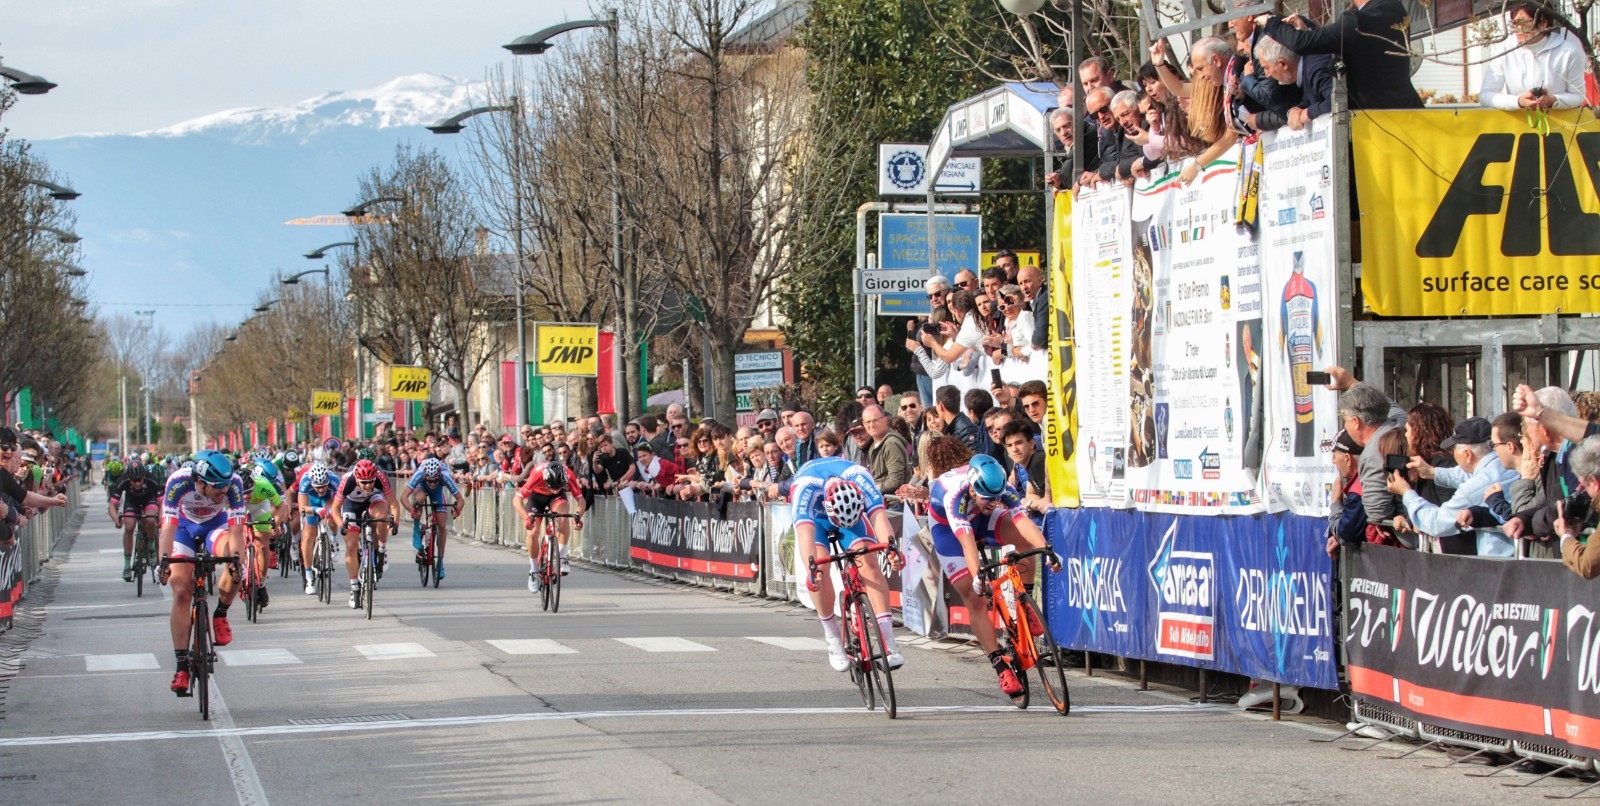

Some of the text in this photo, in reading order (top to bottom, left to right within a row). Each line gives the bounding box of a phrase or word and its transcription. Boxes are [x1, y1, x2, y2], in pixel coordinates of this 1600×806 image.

[907, 221, 955, 232] PIZZRIA
[889, 234, 972, 246] SPAGHTTERIA
[892, 249, 968, 262] MEZZLUNA
[865, 277, 929, 291] Giorgion
[1423, 272, 1510, 292] surface
[1520, 275, 1569, 291] care
[550, 336, 594, 344] SELLE
[541, 346, 593, 363] SMP
[746, 353, 779, 361] TECNICO
[392, 380, 427, 393] SMP
[314, 401, 338, 410] SMP
[1047, 370, 1058, 457] solutions
[855, 474, 880, 501] RUSSIA
[1068, 555, 1127, 612] DEMOGELLA
[1350, 577, 1389, 599] RIESTINA
[1491, 603, 1540, 621] RIESTINA
